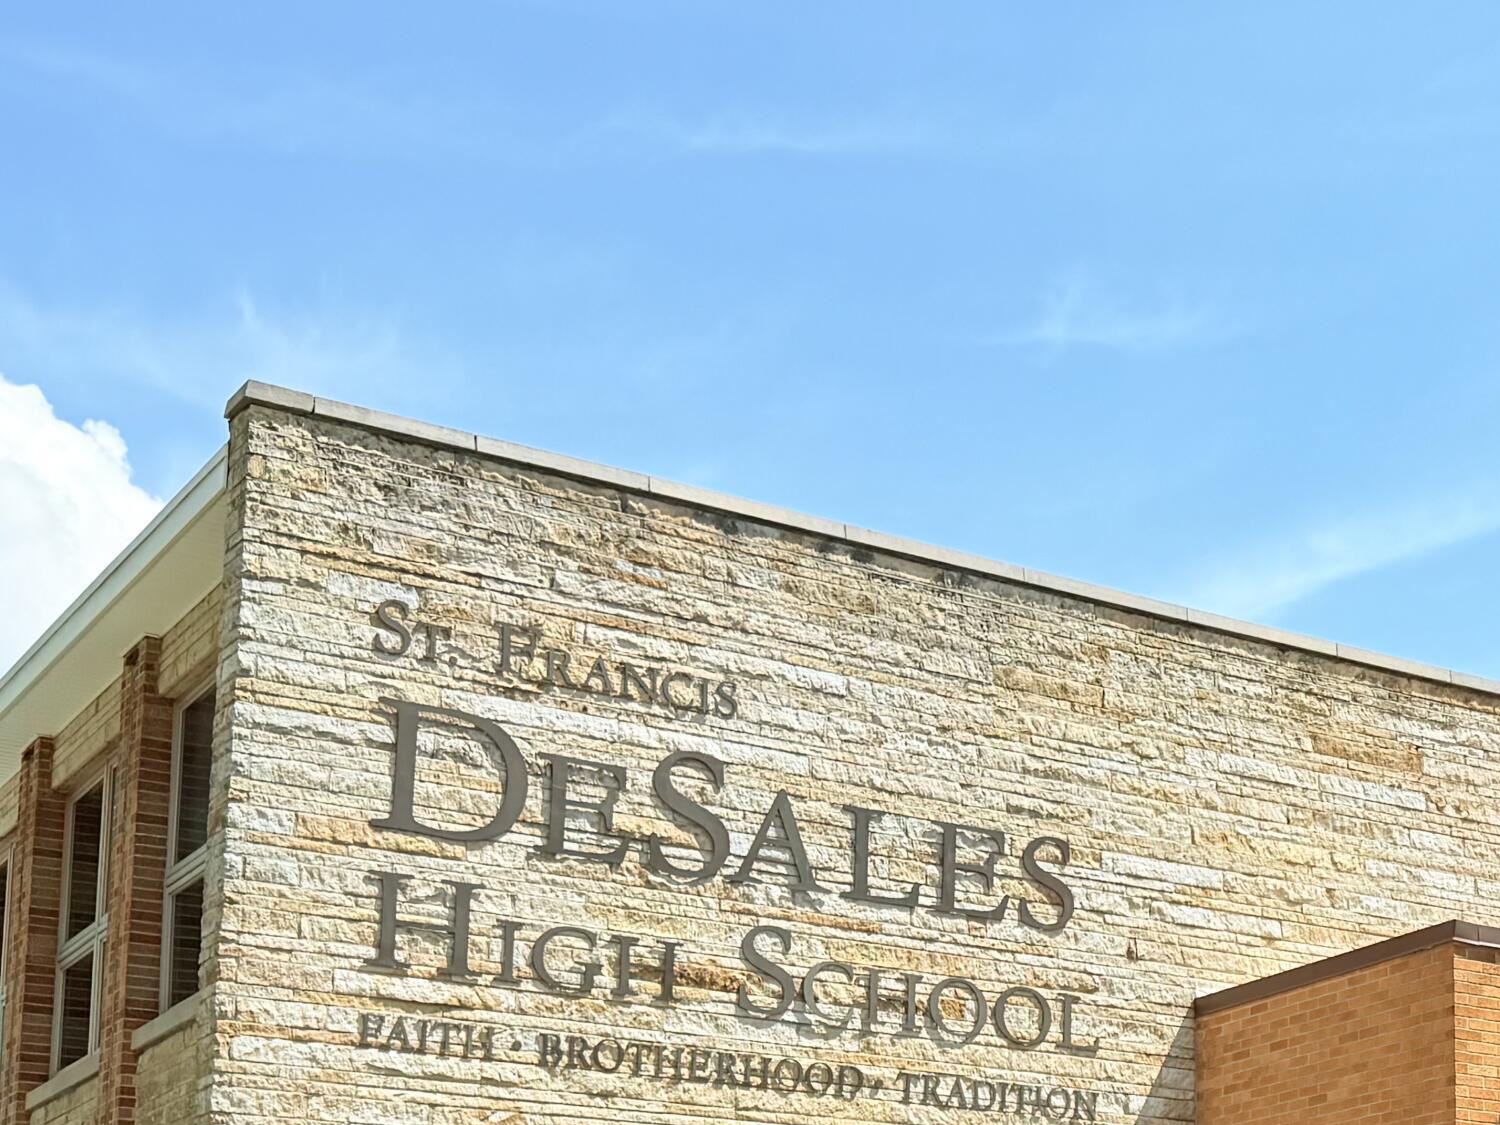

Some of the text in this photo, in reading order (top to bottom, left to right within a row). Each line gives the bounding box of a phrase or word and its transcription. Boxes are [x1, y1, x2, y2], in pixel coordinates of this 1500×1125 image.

[362, 871, 1100, 1056] HIGH SCHOOL
[359, 1014, 1099, 1123] FAITH BROTHERHOOD TRADITION
